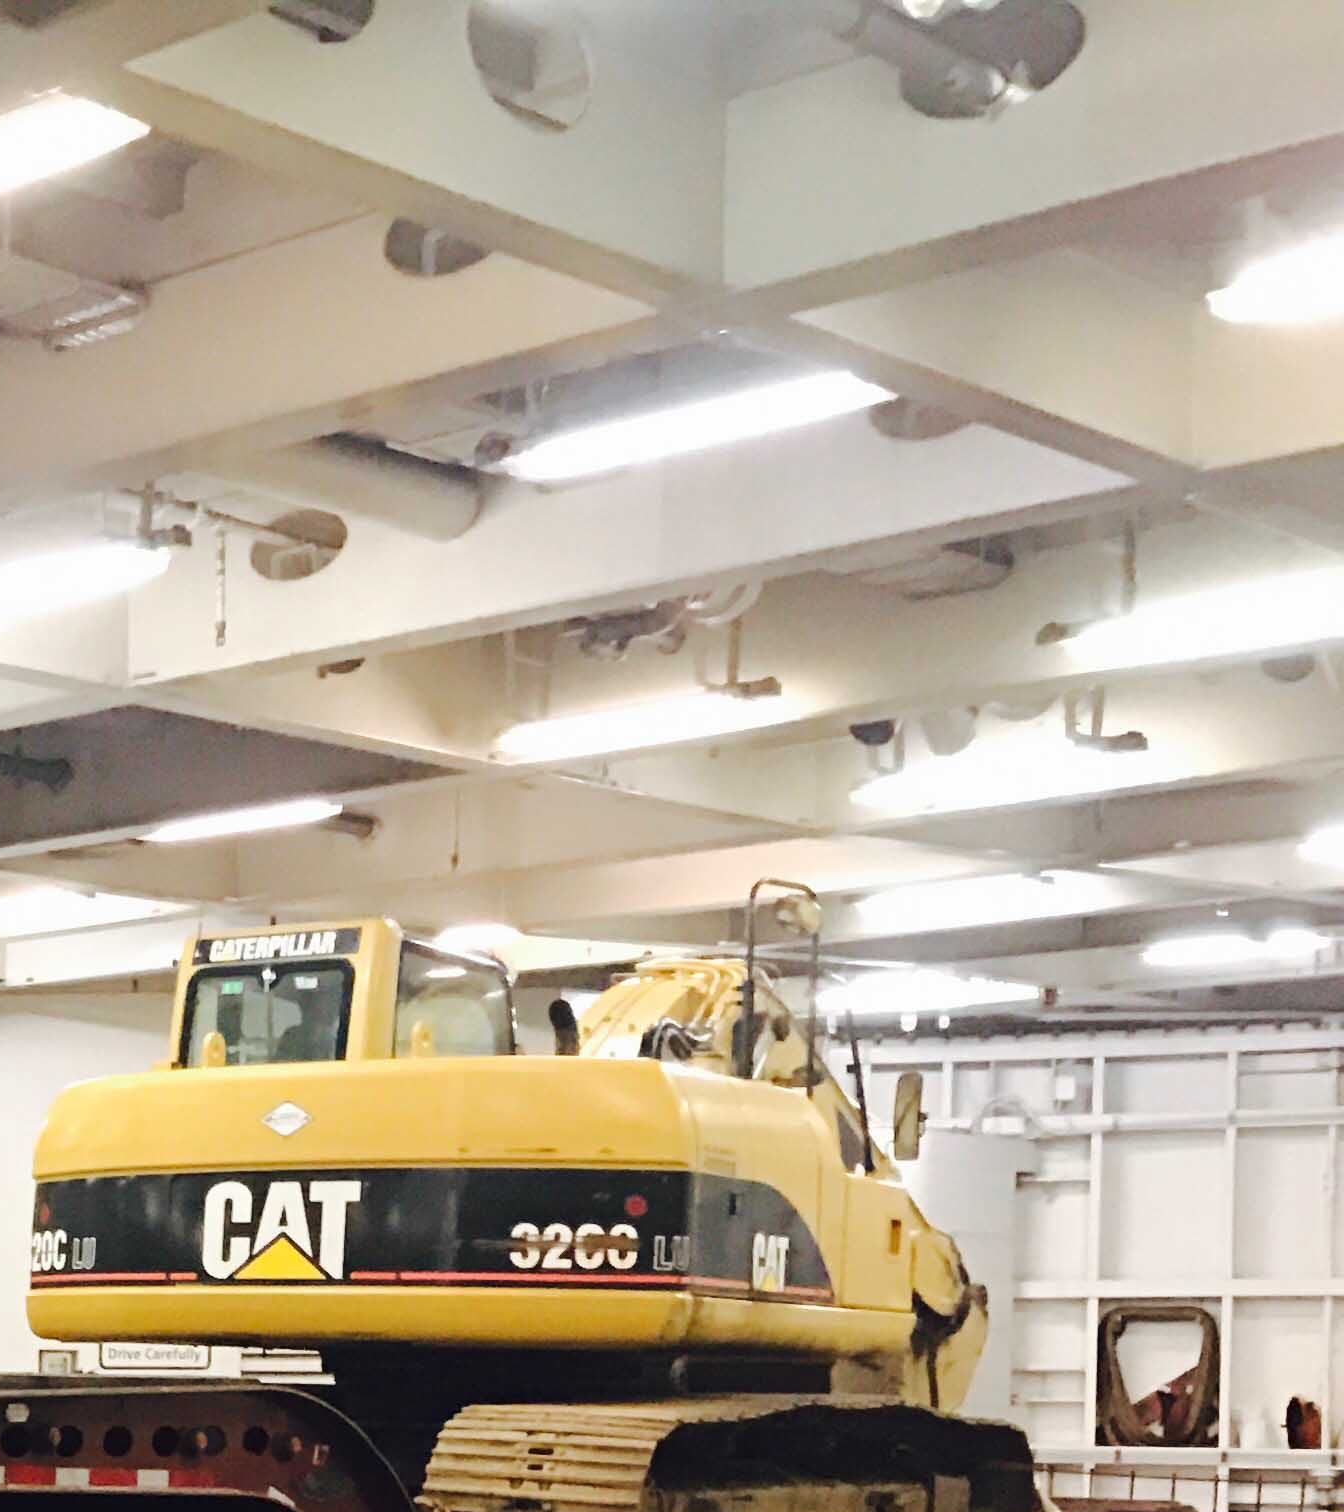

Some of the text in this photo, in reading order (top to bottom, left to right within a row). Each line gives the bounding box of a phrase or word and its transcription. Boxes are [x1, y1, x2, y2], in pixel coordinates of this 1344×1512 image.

[209, 932, 337, 963] CATERPILLAR
[201, 1180, 362, 1280] CAT
[752, 1232, 791, 1292] CAT
[108, 1347, 201, 1363] Drive Carefully
